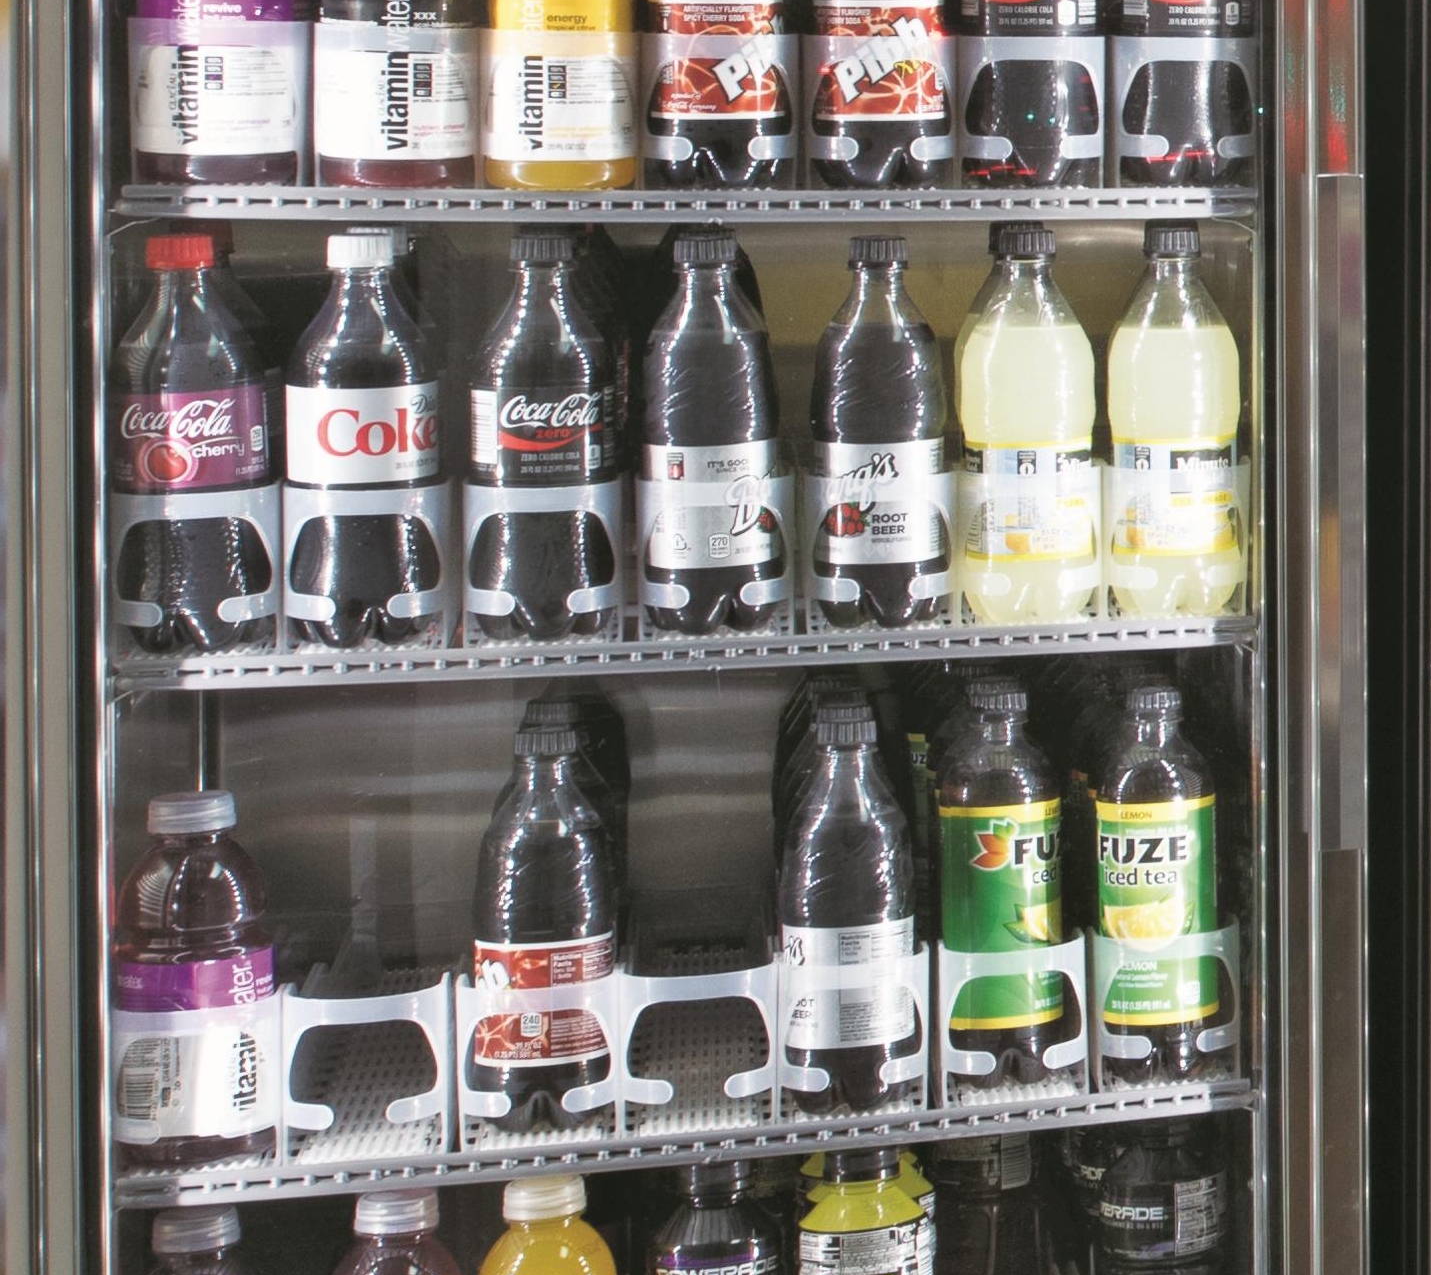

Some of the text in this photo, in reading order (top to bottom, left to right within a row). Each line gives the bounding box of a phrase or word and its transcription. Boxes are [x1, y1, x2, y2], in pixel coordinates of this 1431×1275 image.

[203, 2, 242, 15] revive
[546, 12, 589, 27] energy
[701, 13, 726, 22] CHERRY
[499, 391, 600, 428] Coca-Cola
[120, 397, 238, 440] Coca-Cola
[315, 406, 438, 457] Coke
[536, 428, 571, 440] zero
[190, 442, 246, 460] cherry
[871, 511, 909, 524] ROOT
[871, 524, 906, 537] BEER
[710, 536, 729, 548] 270
[1120, 811, 1153, 820] LEMON
[1099, 834, 1188, 865] FUZE
[1104, 868, 1178, 886] iced tea
[523, 1014, 540, 1025] 240
